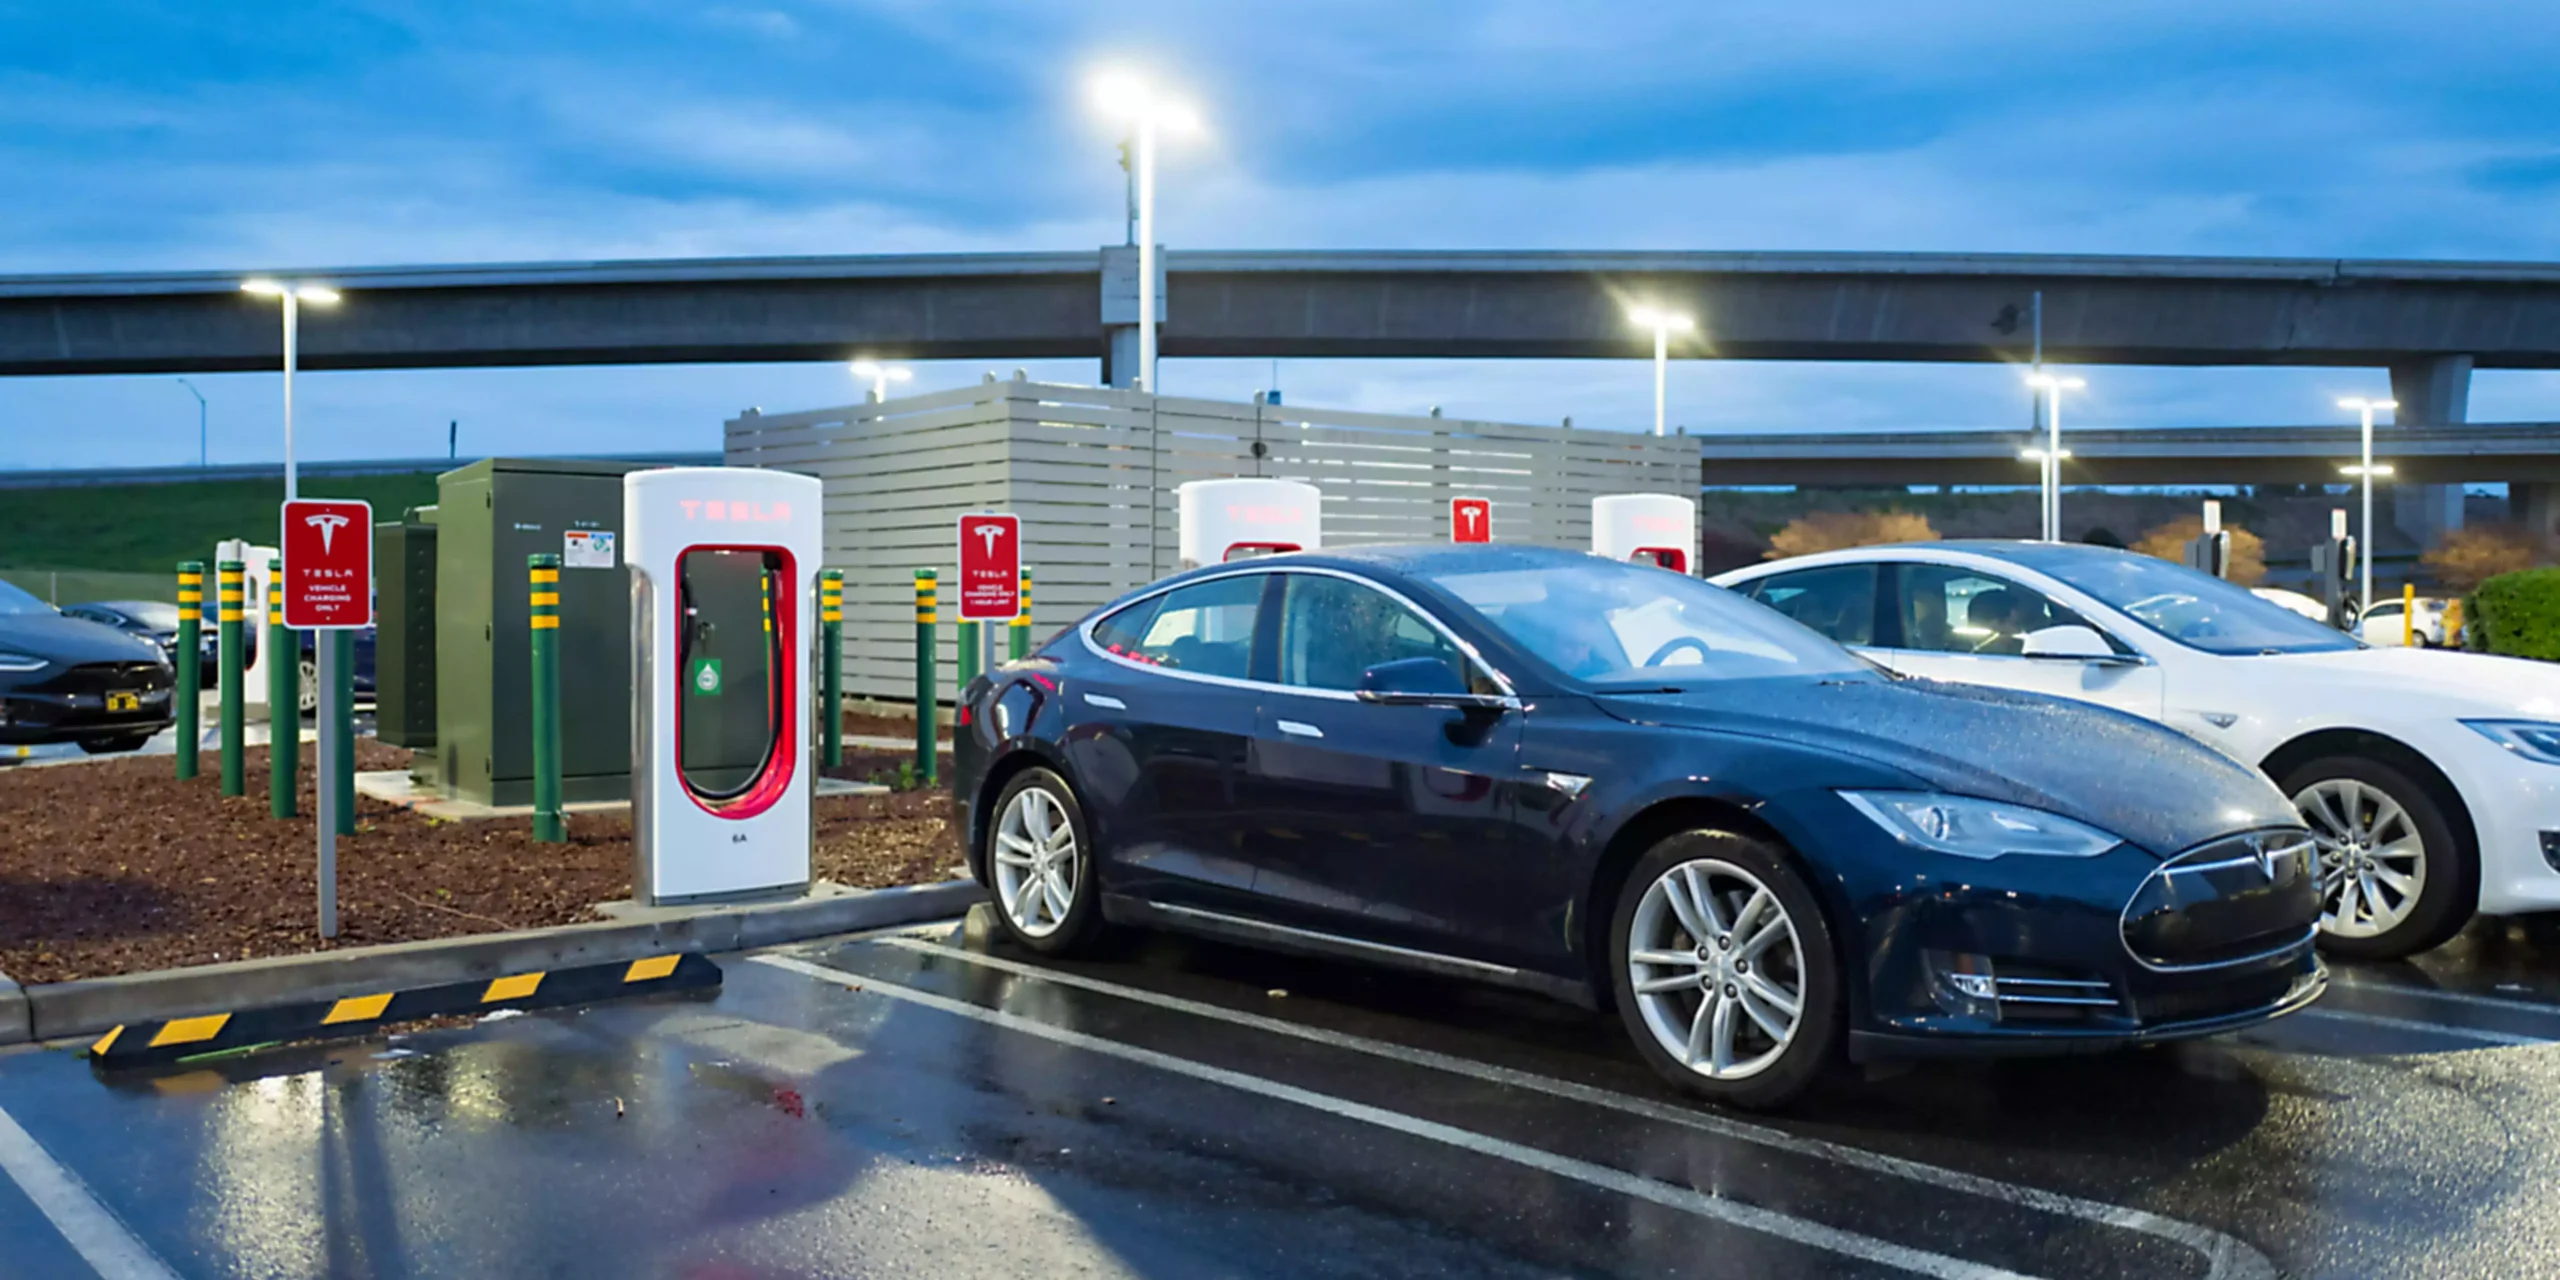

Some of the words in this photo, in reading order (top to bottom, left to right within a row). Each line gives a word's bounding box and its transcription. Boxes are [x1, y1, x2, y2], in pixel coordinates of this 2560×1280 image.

[679, 499, 791, 521] TESLA
[303, 568, 353, 578] TESLA
[972, 569, 1008, 578] TESLA
[309, 584, 346, 592] VEHICLE
[304, 594, 351, 602] CHARGING
[315, 604, 340, 612] ONLY
[732, 833, 747, 843] 6A
